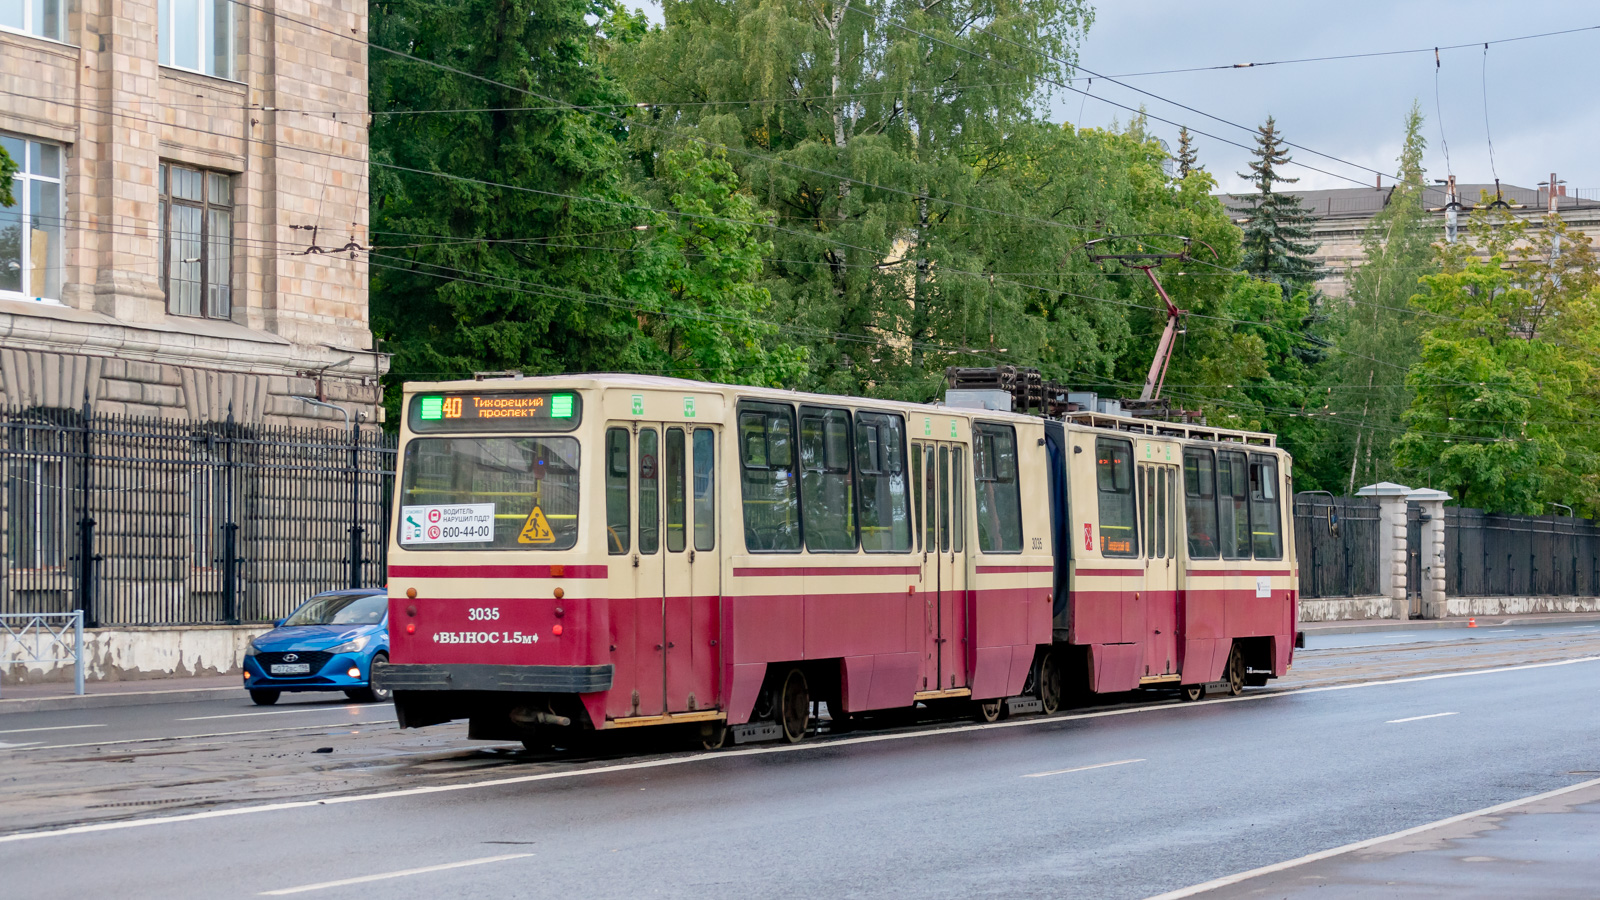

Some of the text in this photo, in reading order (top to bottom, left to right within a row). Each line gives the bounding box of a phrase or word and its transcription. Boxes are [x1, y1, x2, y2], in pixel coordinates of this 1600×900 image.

[443, 397, 543, 418] 40 Тихорецкий
[479, 409, 536, 418] проспект
[443, 508, 474, 516] ВОДИТЕЛЬ
[474, 515, 490, 523] ПДД?
[443, 526, 490, 538] 600-44-00
[1031, 537, 1043, 550] 3035
[468, 607, 500, 620] 3035
[439, 632, 532, 644] ВЫНОС 1.5м
